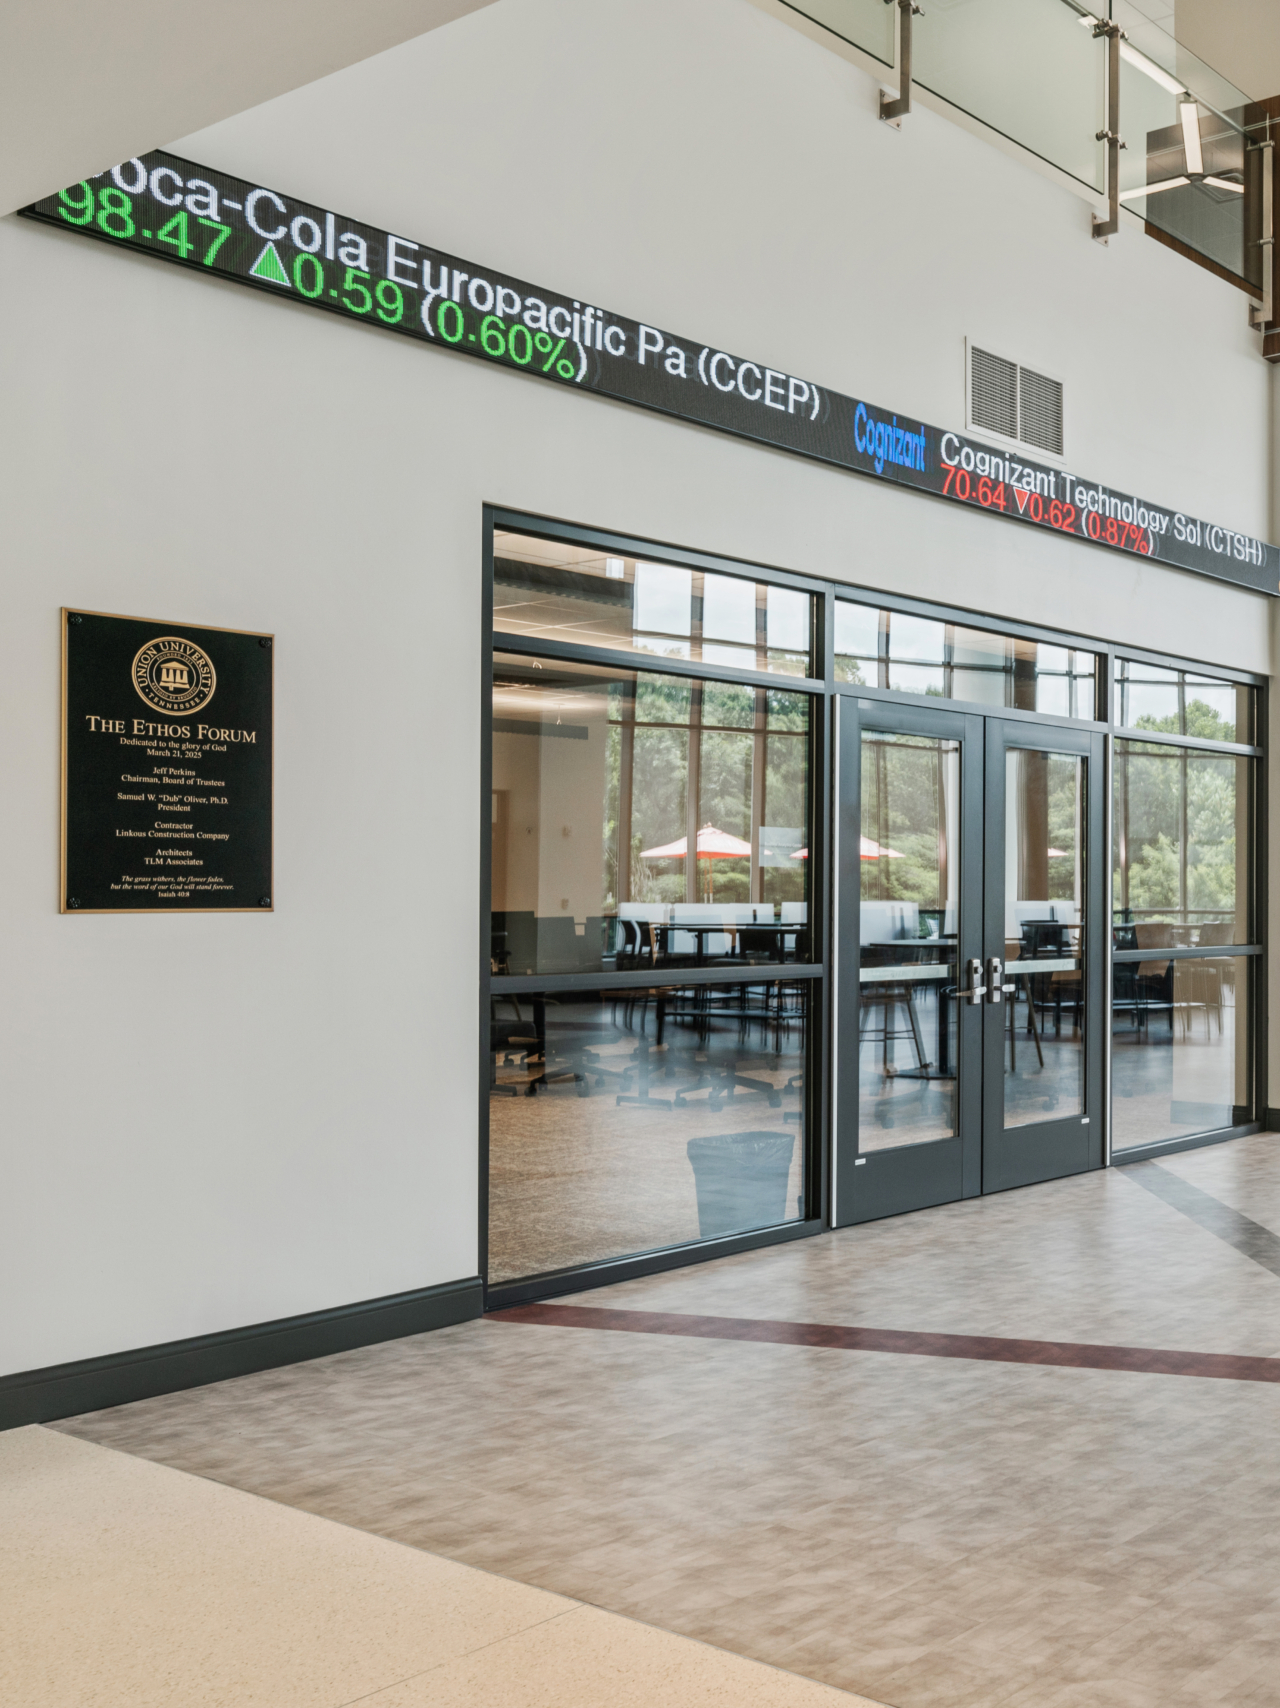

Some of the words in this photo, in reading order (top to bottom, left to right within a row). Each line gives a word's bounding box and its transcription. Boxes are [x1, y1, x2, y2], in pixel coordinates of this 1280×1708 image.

[58, 180, 231, 267] 98.47
[293, 252, 403, 323] 0.59
[421, 292, 588, 382] (0.60%)
[93, 157, 369, 272] oca-Cola
[387, 234, 626, 356] Europacific
[638, 324, 687, 378] Pa
[698, 347, 820, 420] (CCEP)
[854, 402, 925, 474] Cognizant
[940, 432, 1056, 498] Cognizant
[1061, 472, 1169, 535] Technology
[1174, 513, 1201, 547] Sol
[1204, 525, 1262, 566] (CTSH)
[941, 463, 1006, 512] 70.64
[1030, 493, 1075, 533] 0.62
[1082, 508, 1153, 556] (0.87%)
[137, 646, 158, 687] UNION
[159, 641, 211, 695] UNIVERSITY
[148, 692, 201, 710] TENNESSEE
[86, 715, 126, 733] THE
[132, 719, 191, 739] ETHOS
[197, 724, 257, 744] FORUM
[119, 737, 157, 747] Dedicated
[158, 740, 167, 748] to
[168, 741, 180, 749] the
[181, 742, 200, 751] glory
[202, 743, 211, 751] of
[211, 743, 227, 752] God
[147, 748, 171, 757] March
[172, 750, 183, 759] 21,
[184, 751, 202, 759] 2025
[152, 766, 168, 775] Jeff
[168, 767, 196, 776] Perkins
[121, 774, 161, 784] Chairman,
[162, 776, 185, 785] Board
[186, 777, 195, 785] of
[196, 778, 226, 787] Trustees
[117, 792, 145, 801] Samuel
[147, 794, 157, 802] W.
[184, 795, 209, 805] Oliver,
[210, 796, 229, 805] Ph.D.
[157, 803, 191, 812] President
[154, 821, 194, 830] Contractor
[115, 829, 147, 837] Linkous
[148, 829, 195, 839] Construction
[196, 831, 230, 841] Company
[155, 848, 193, 857] Architects
[144, 857, 164, 865] TLM
[165, 857, 204, 866] Associates
[186, 876, 207, 884] flower
[149, 883, 158, 891] of
